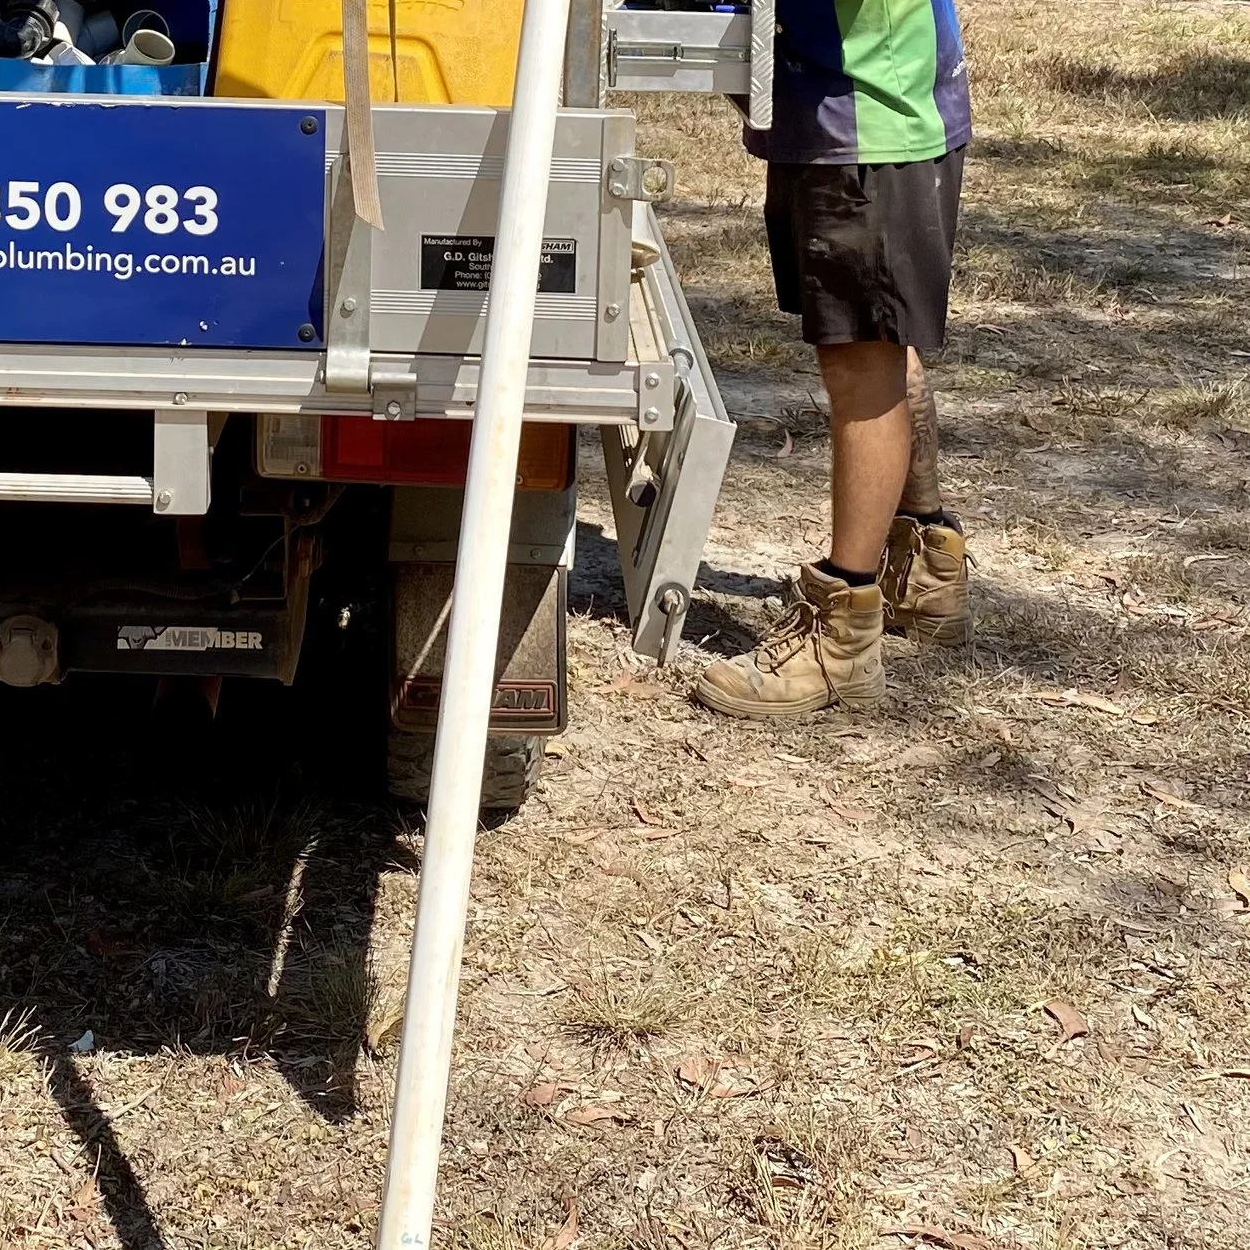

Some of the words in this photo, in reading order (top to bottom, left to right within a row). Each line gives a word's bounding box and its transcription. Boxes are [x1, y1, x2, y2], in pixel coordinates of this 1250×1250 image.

[103, 184, 219, 236] 983
[424, 238, 471, 246] Manufactured
[473, 239, 482, 247] By
[444, 251, 465, 261] G.D.
[455, 271, 482, 279] Phone:
[170, 630, 263, 650] MEMBER
